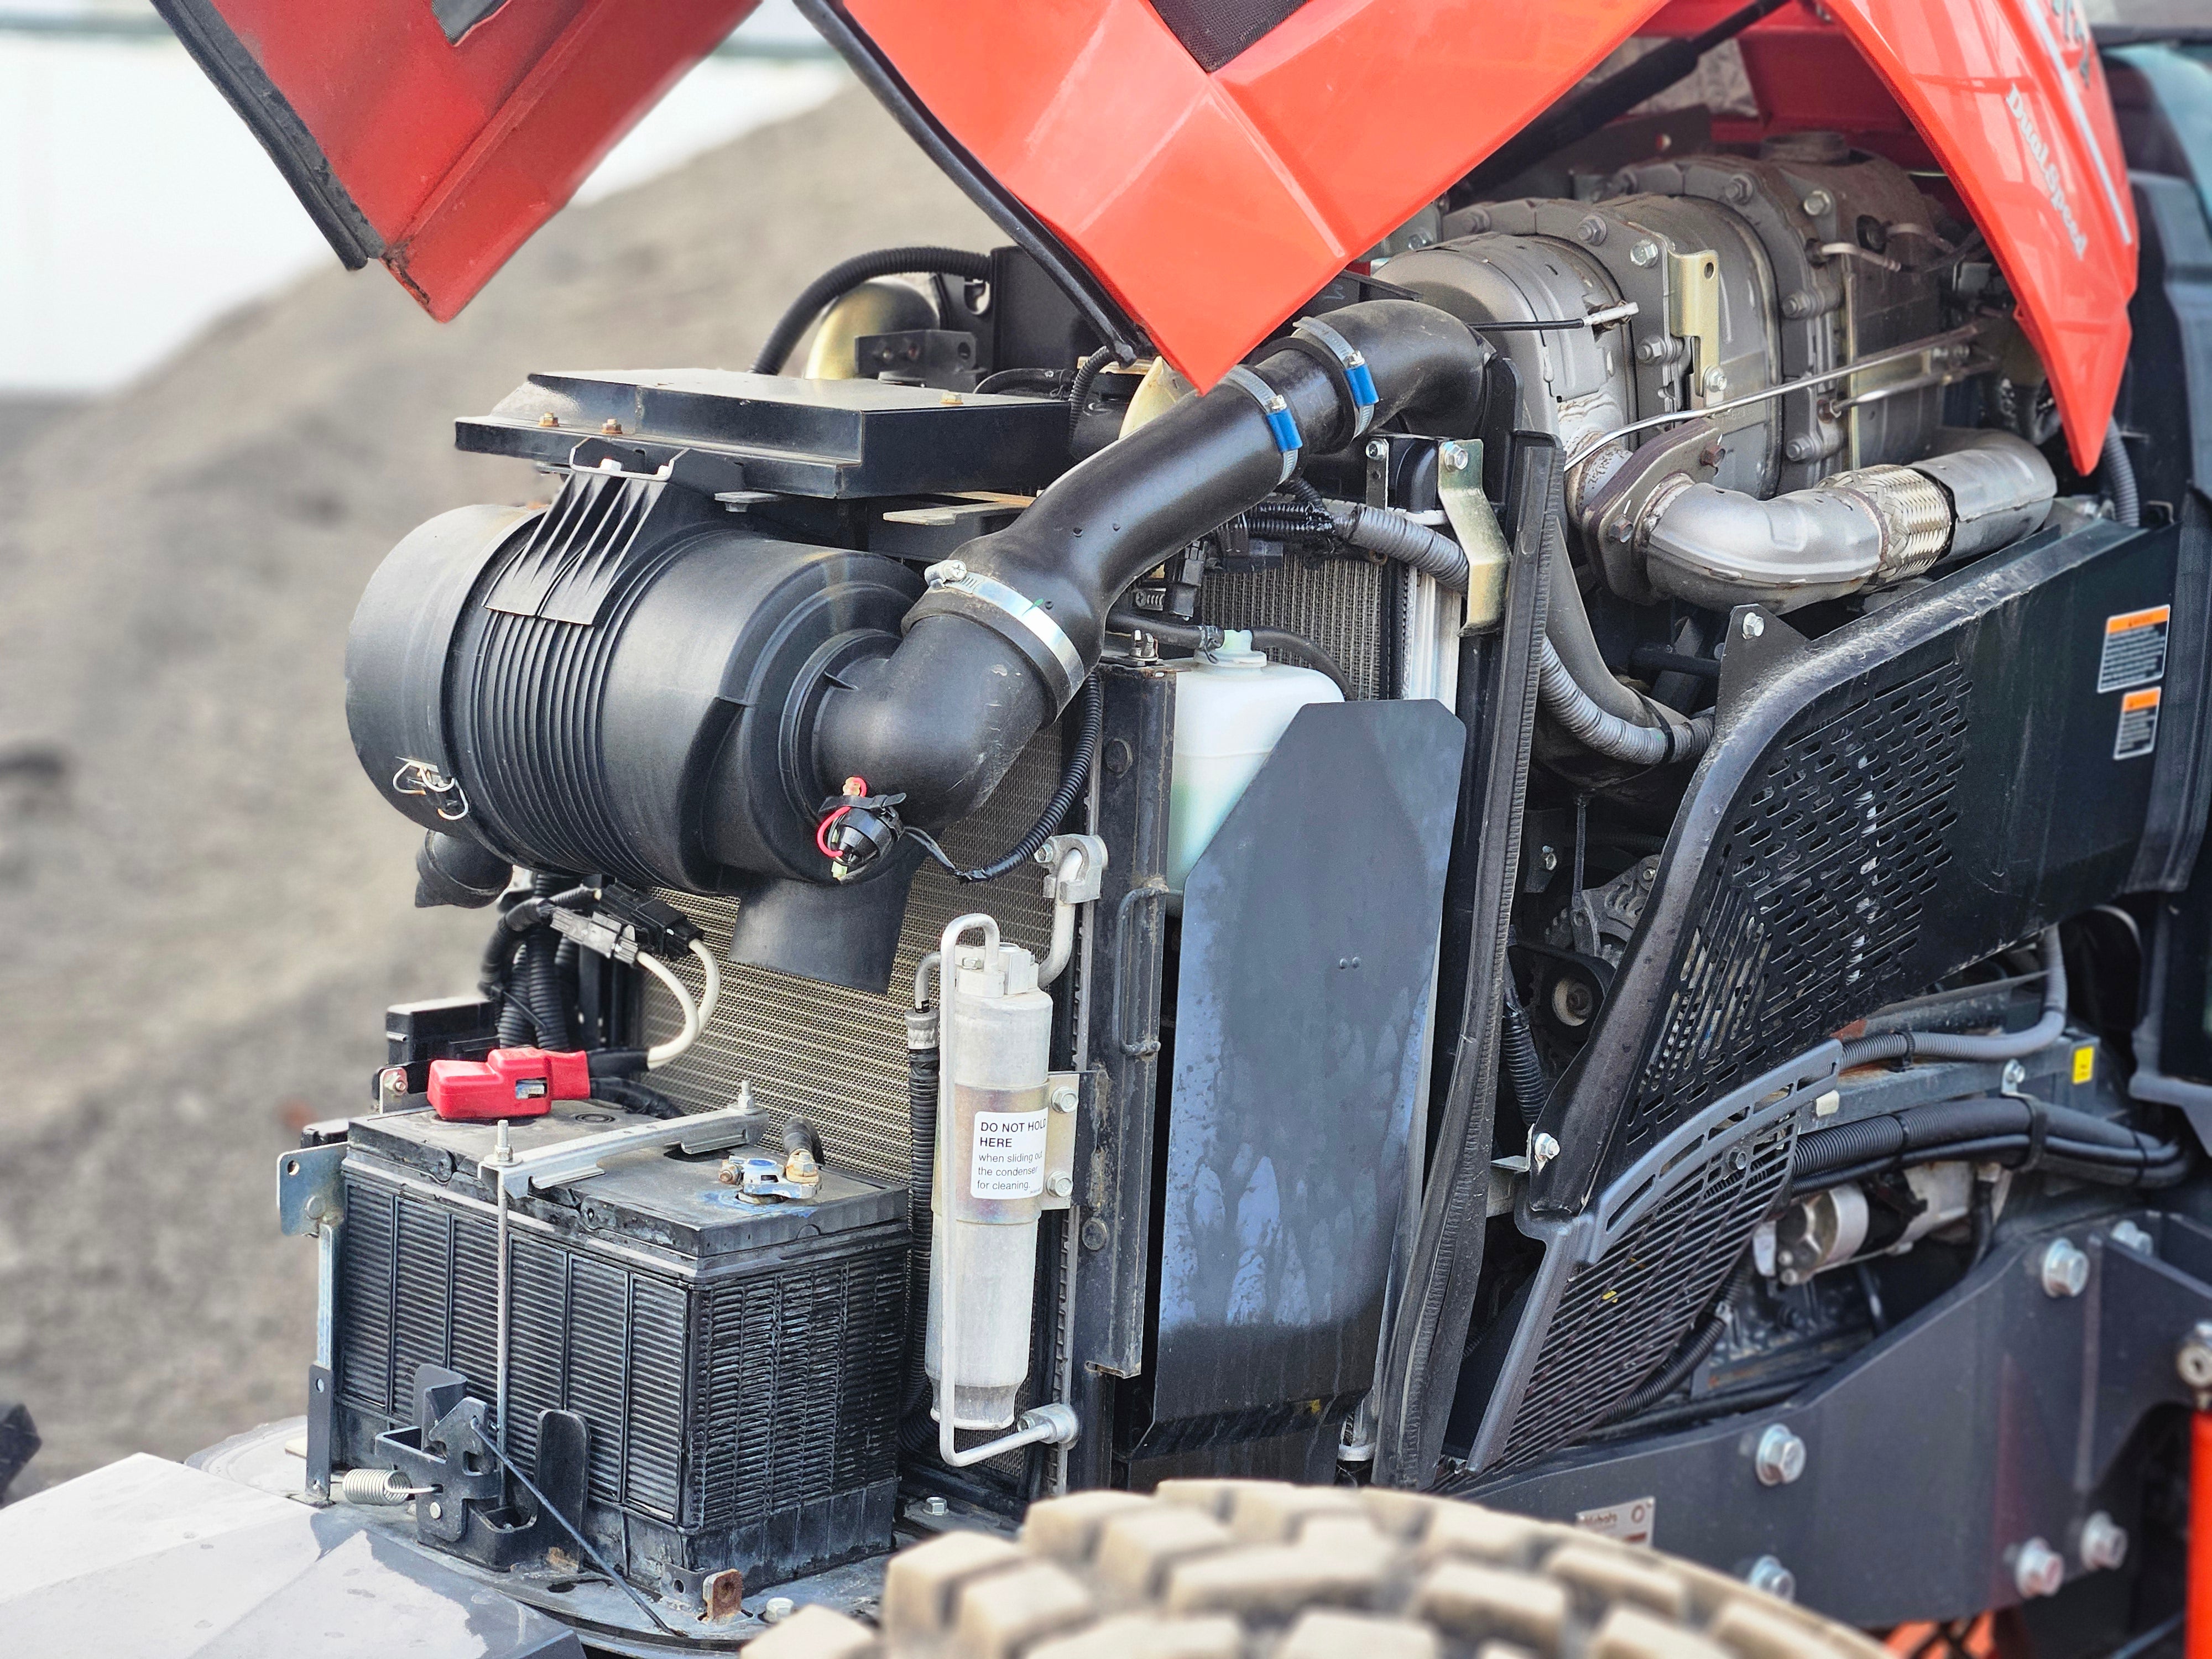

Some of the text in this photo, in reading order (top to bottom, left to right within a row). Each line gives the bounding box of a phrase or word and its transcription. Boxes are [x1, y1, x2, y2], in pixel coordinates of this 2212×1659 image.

[980, 1118, 1046, 1133] DO NOT HOLD
[980, 1137, 1013, 1147] HERE
[979, 1153, 1004, 1162] when
[1007, 1153, 1033, 1163] sliding
[978, 1166, 1038, 1176] the condenser
[977, 1180, 990, 1190] for
[992, 1181, 1030, 1191] cleaning.
